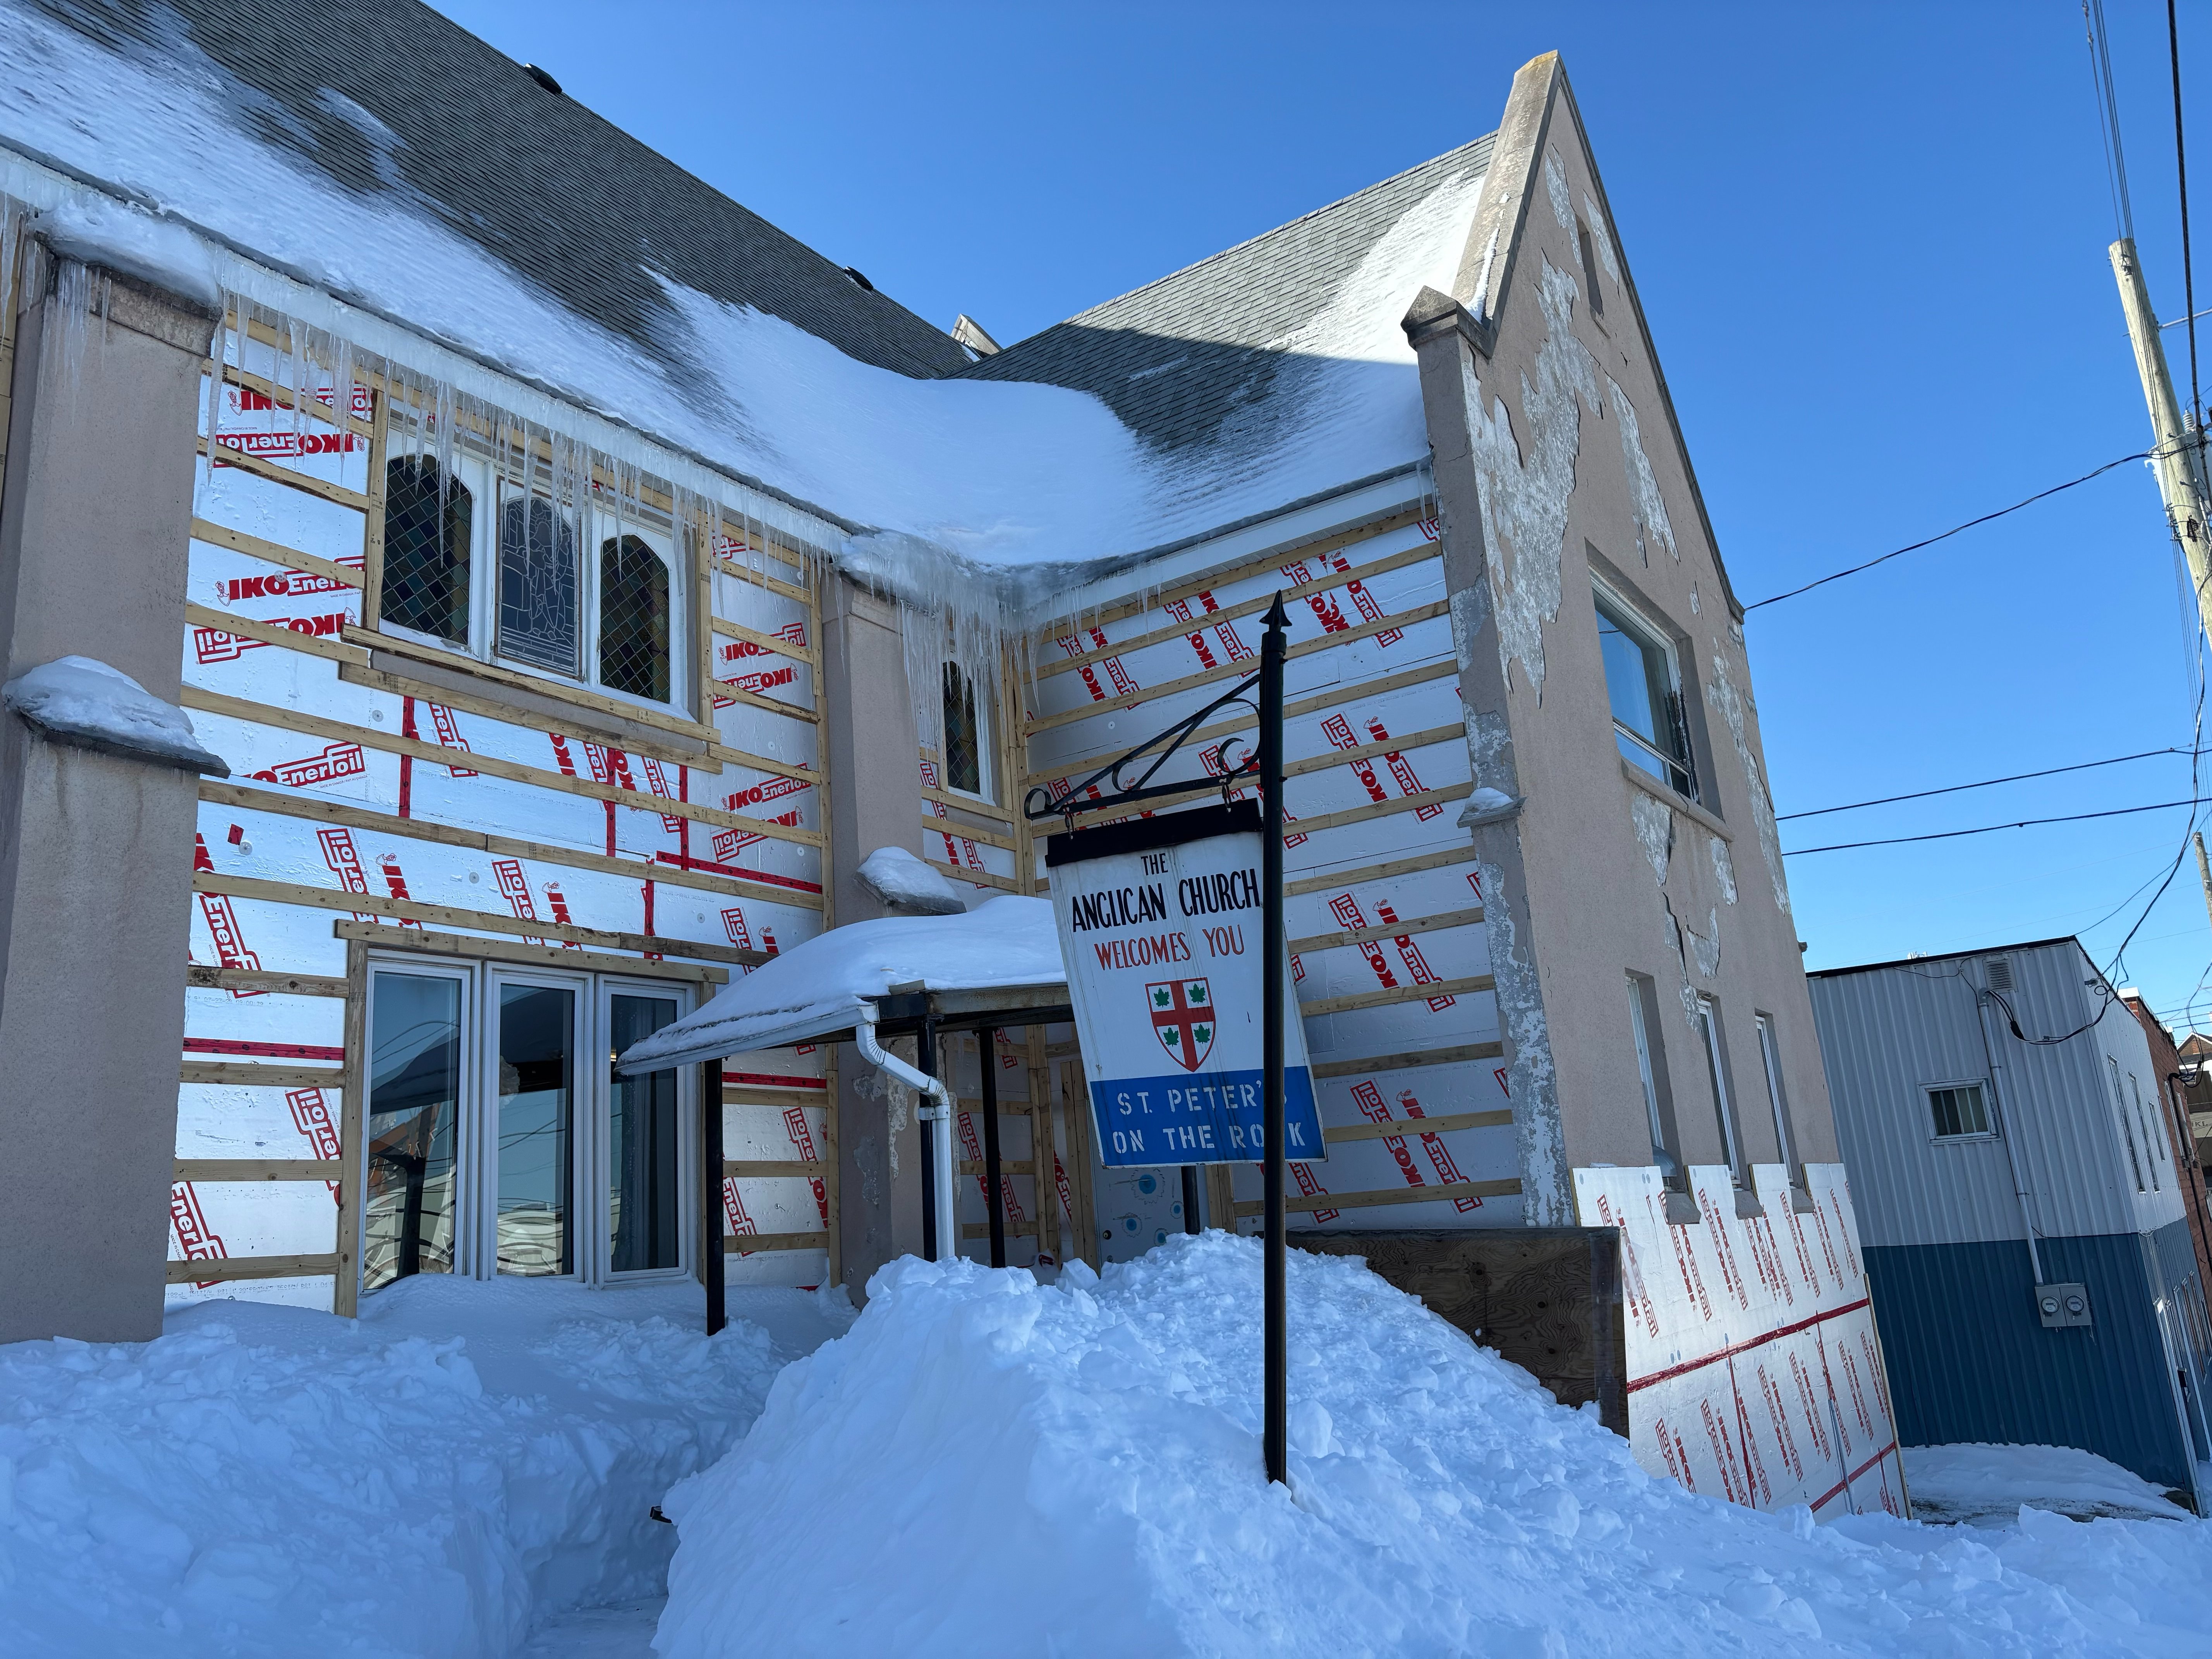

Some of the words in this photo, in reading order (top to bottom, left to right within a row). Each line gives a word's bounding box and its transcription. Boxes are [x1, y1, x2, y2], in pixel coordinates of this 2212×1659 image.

[1141, 854, 1168, 876] THE
[1072, 883, 1166, 933] ANGLICAN
[1178, 869, 1260, 917] CHURCH
[1094, 932, 1191, 971] WELCOMES
[1202, 924, 1245, 957] YOU
[1117, 1092, 1153, 1115] ST.
[1168, 1080, 1287, 1114] PETER'
[1113, 1129, 1145, 1154] ON
[1163, 1125, 1216, 1151] THE
[1229, 1122, 1306, 1149] ROK
